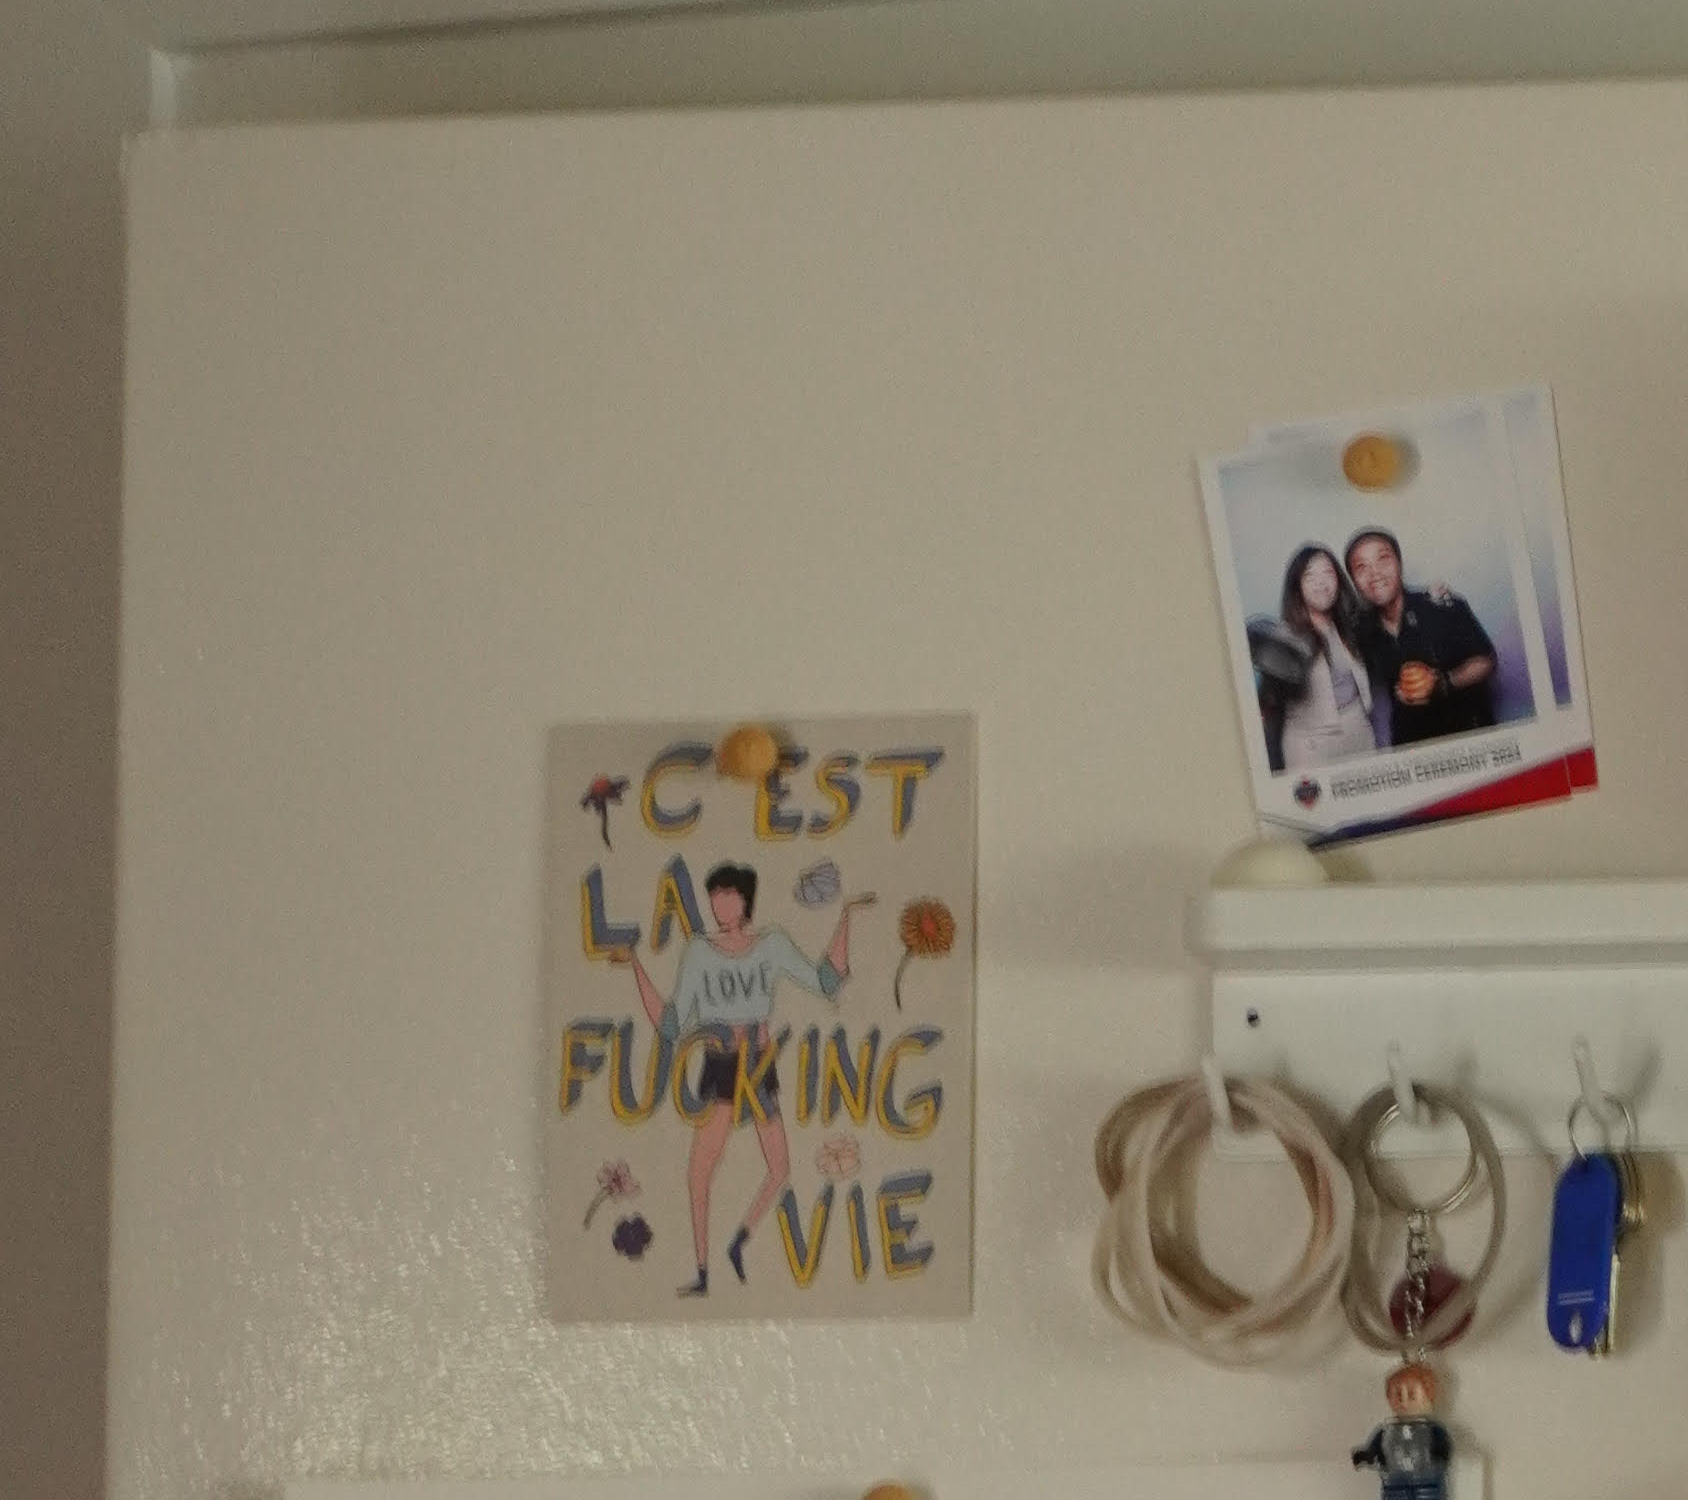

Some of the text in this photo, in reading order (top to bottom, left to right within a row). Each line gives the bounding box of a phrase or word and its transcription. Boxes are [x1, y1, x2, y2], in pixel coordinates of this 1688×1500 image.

[580, 853, 706, 962] LA
[702, 960, 771, 1006] LOVE
[559, 1017, 944, 1140] FUCKING
[777, 1169, 936, 1286] VIE
